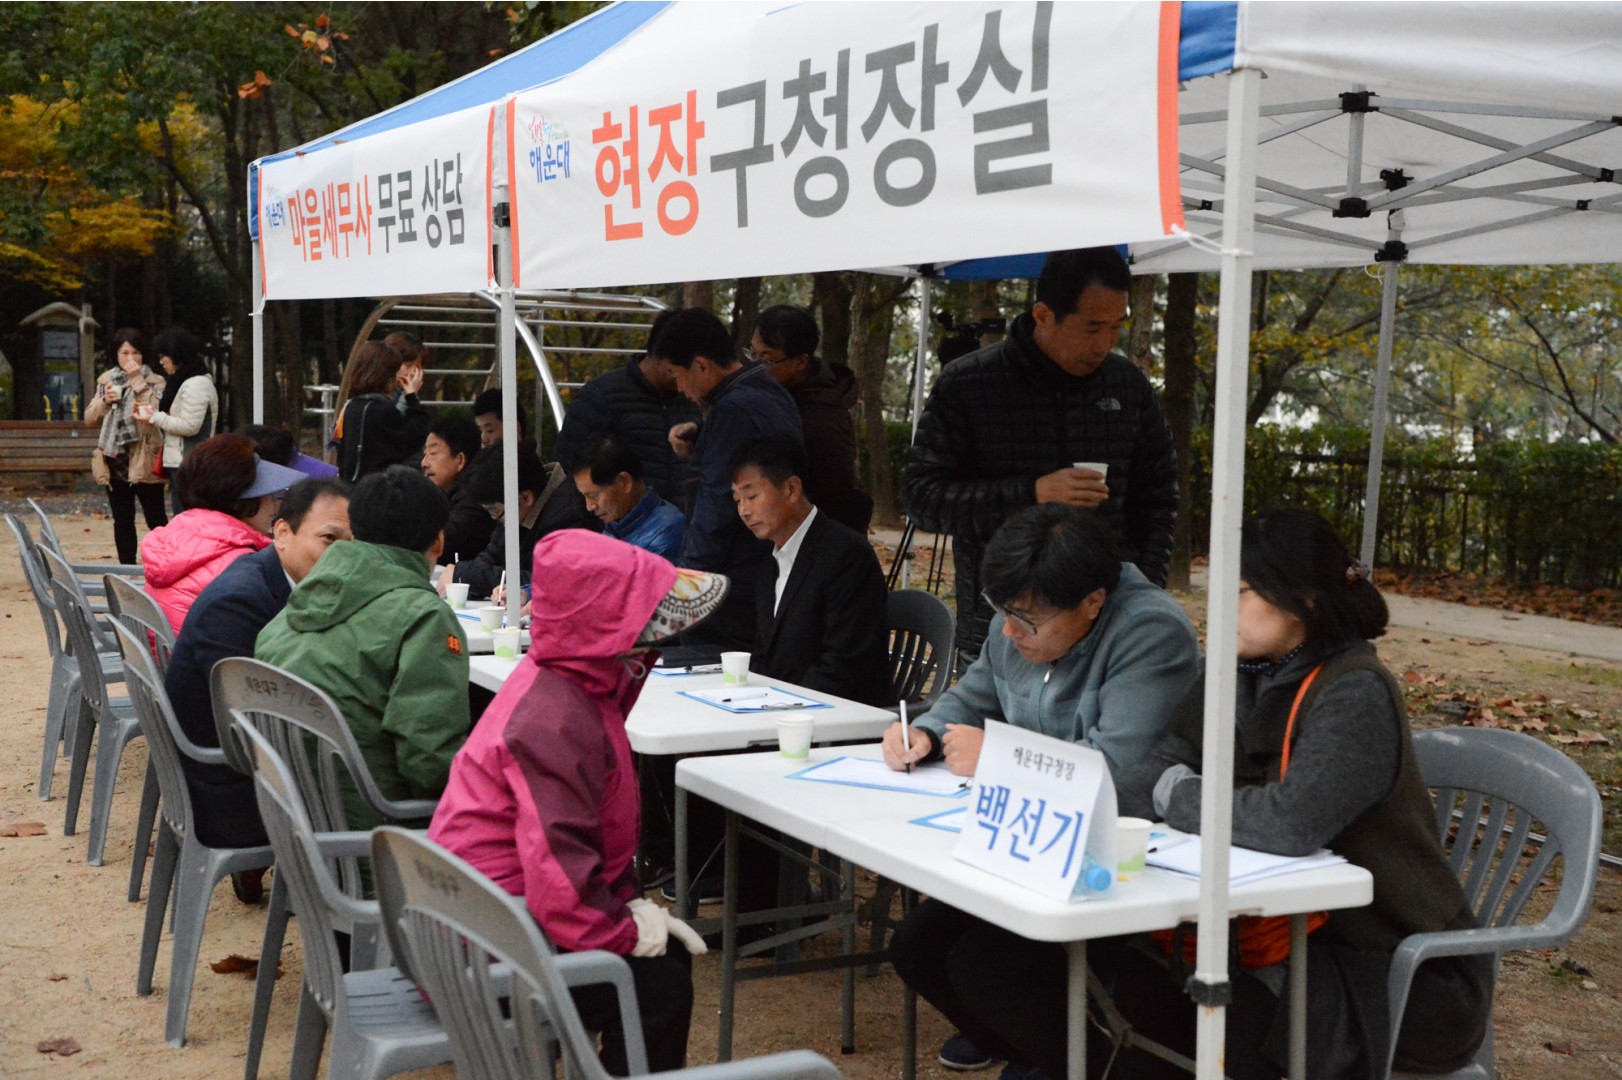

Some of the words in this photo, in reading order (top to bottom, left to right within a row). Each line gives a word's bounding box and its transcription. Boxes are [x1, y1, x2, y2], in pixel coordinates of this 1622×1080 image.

[529, 140, 571, 183] 해운대
[287, 174, 373, 262] 마을세무사
[1014, 746, 1076, 782] 해운대구청장
[976, 784, 1084, 880] 백선기
